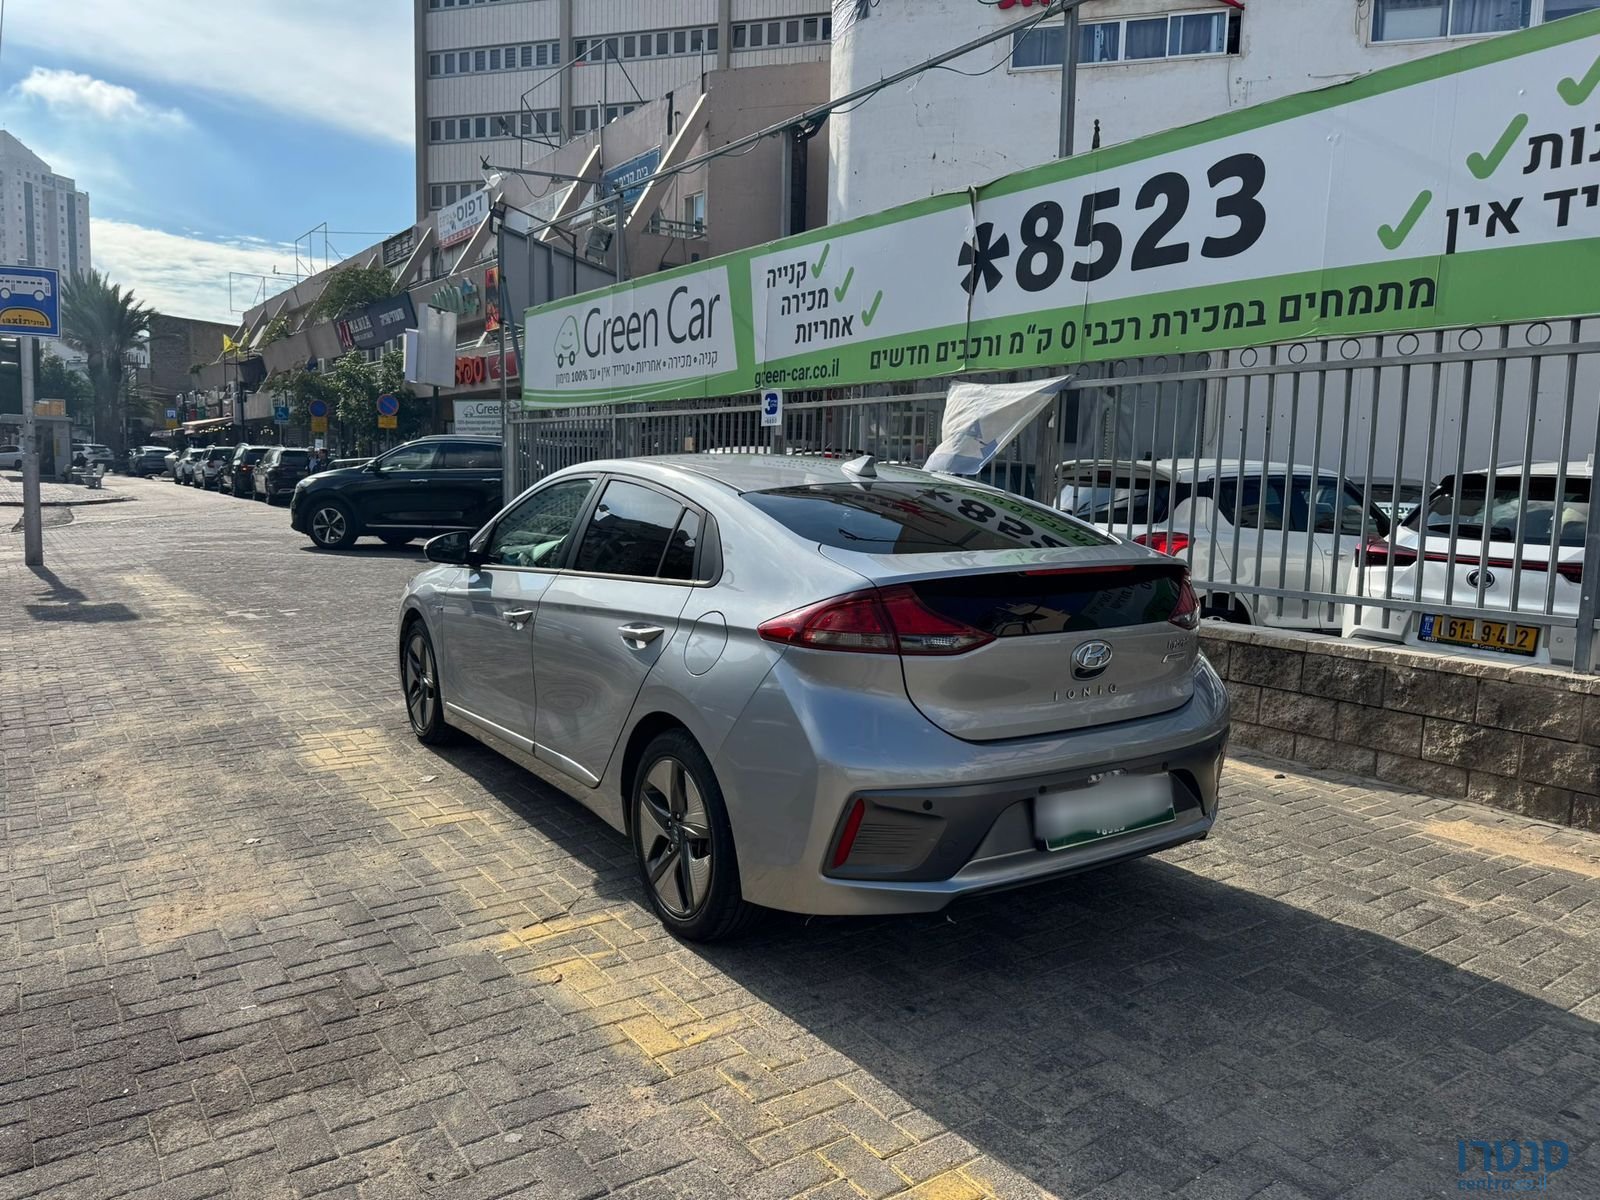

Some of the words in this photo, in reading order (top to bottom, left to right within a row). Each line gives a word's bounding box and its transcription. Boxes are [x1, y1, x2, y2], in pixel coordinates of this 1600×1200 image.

[456, 195, 483, 222] דפוס
[1446, 197, 1523, 254] אין
[766, 260, 808, 289] קנייה
[781, 287, 829, 316] מכירה
[1279, 277, 1436, 322] מתמחים
[584, 306, 658, 359] Green
[667, 285, 721, 343] Car
[794, 315, 854, 344] אחריות
[1084, 317, 1142, 346] רכבי
[1150, 299, 1266, 340] במכירת
[668, 354, 692, 369] מכירה
[698, 350, 718, 368] קניה
[870, 342, 929, 370] חדשים
[936, 331, 1001, 365] ורכבים
[571, 370, 588, 383] 100%
[635, 359, 662, 374] אחריות
[754, 358, 840, 388] green-car.co.il
[1053, 684, 1118, 702] IONIQ
